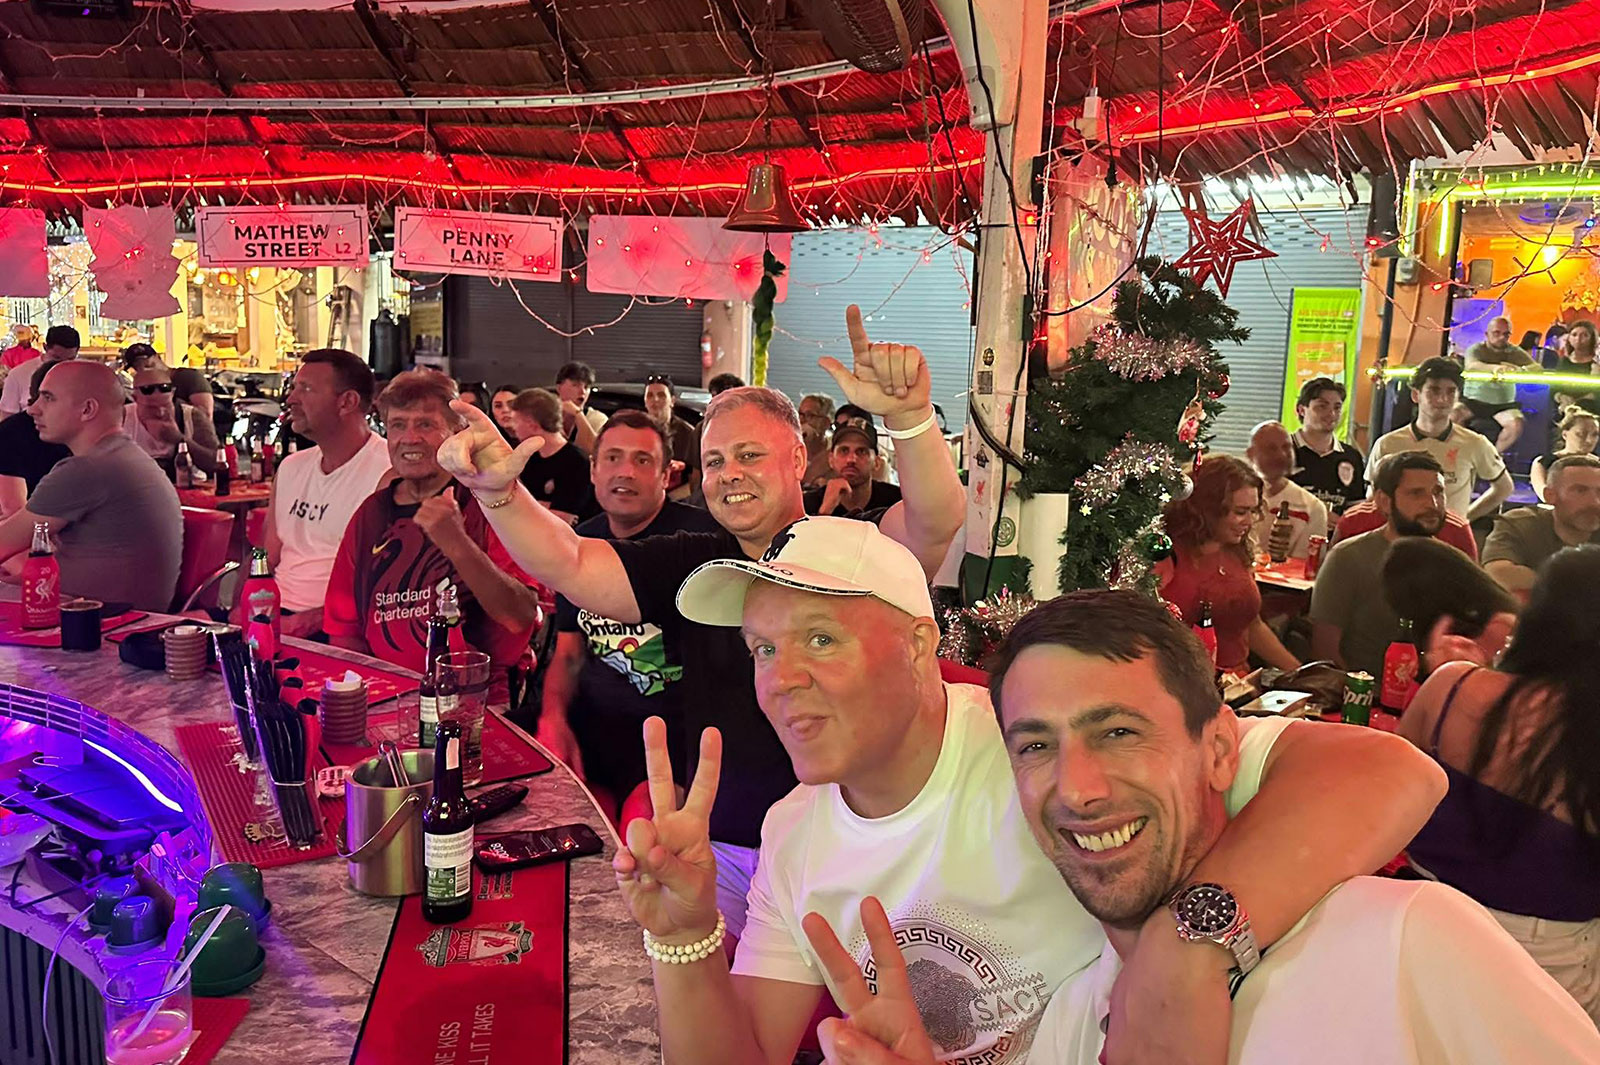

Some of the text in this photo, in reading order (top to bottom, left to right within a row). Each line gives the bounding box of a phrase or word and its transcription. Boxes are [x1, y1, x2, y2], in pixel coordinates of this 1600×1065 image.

[234, 224, 330, 240] MATHEW
[443, 229, 514, 249] PENNY
[244, 242, 351, 258] STREET L2
[450, 248, 504, 266] LANE
[375, 586, 432, 608] Standard
[373, 602, 431, 624] Chartered
[471, 1003, 496, 1039] TAKES
[437, 1021, 461, 1049] KISS
[470, 1042, 491, 1052] IT
